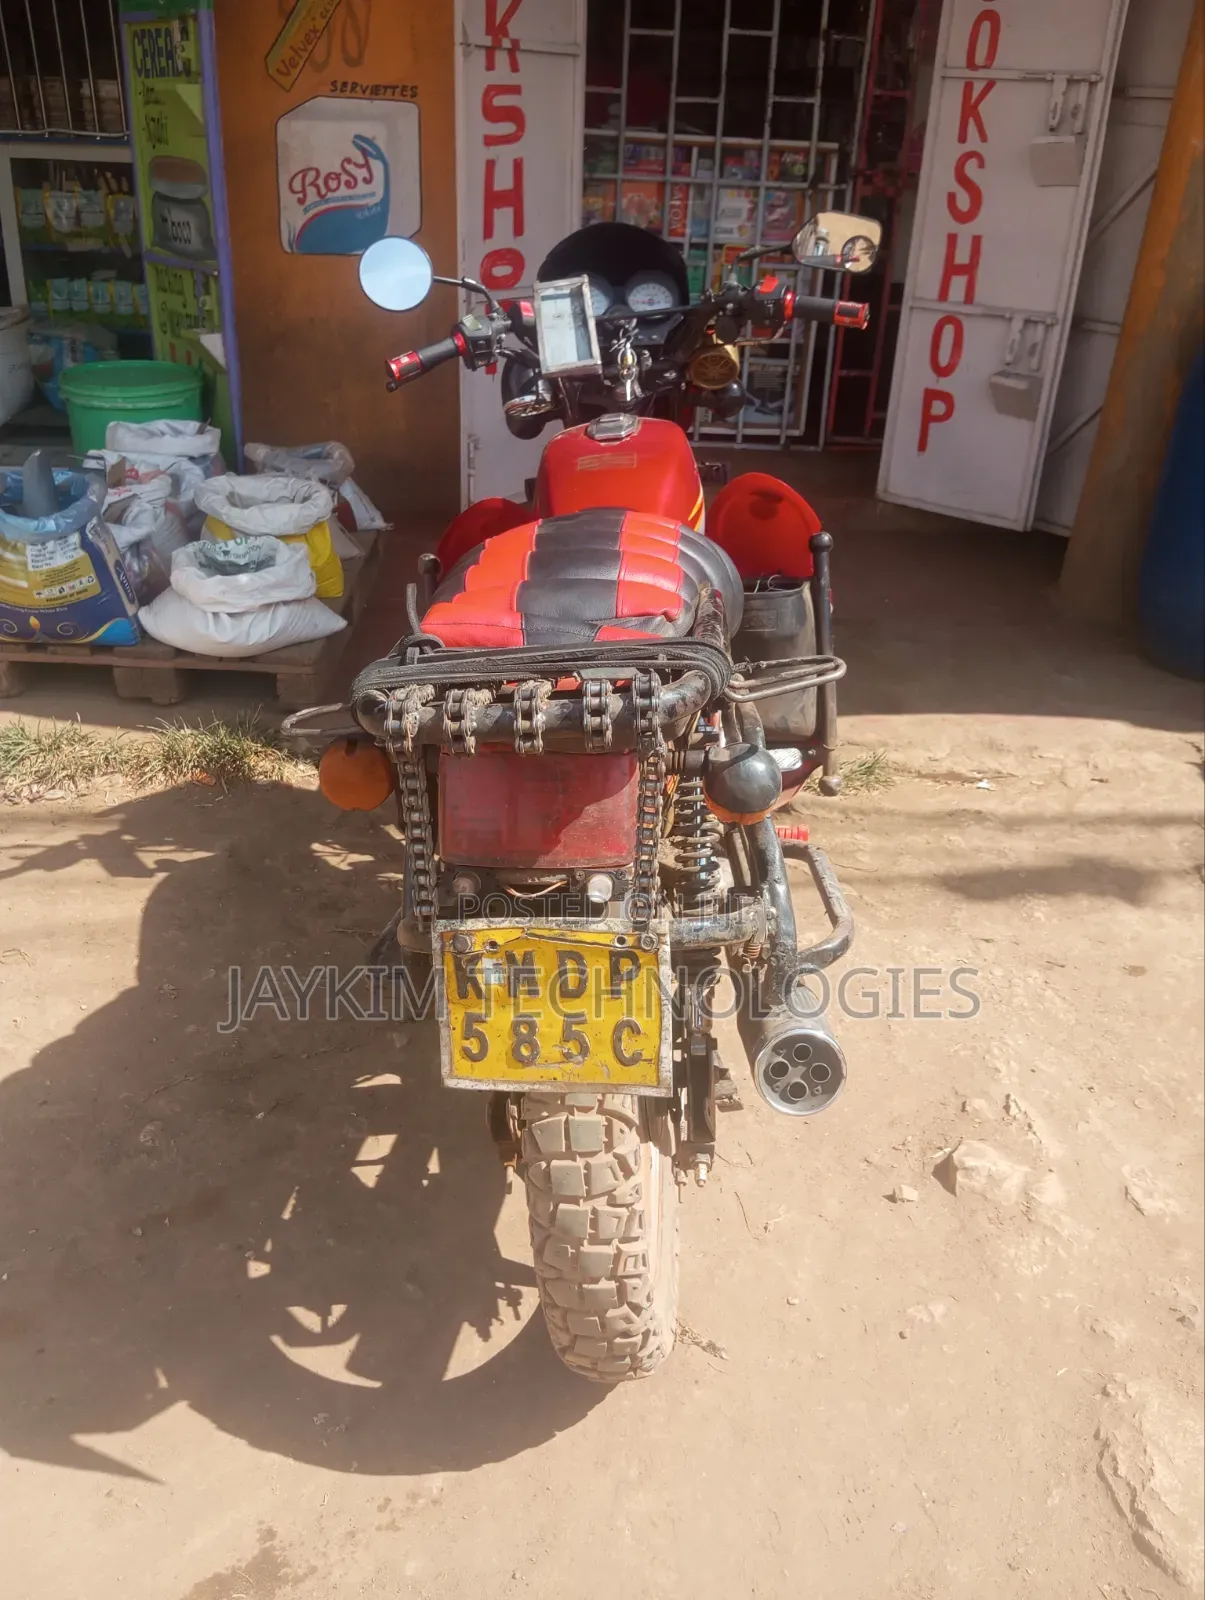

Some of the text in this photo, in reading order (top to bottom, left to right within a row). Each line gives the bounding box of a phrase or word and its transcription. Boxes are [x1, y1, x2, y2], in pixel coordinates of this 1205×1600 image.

[330, 80, 419, 98] SERVIETTES
[479, 0, 526, 375] KSHO
[917, 0, 1002, 456] OKSHOP
[453, 950, 642, 1000] KMDP
[462, 1012, 643, 1067] 585C
